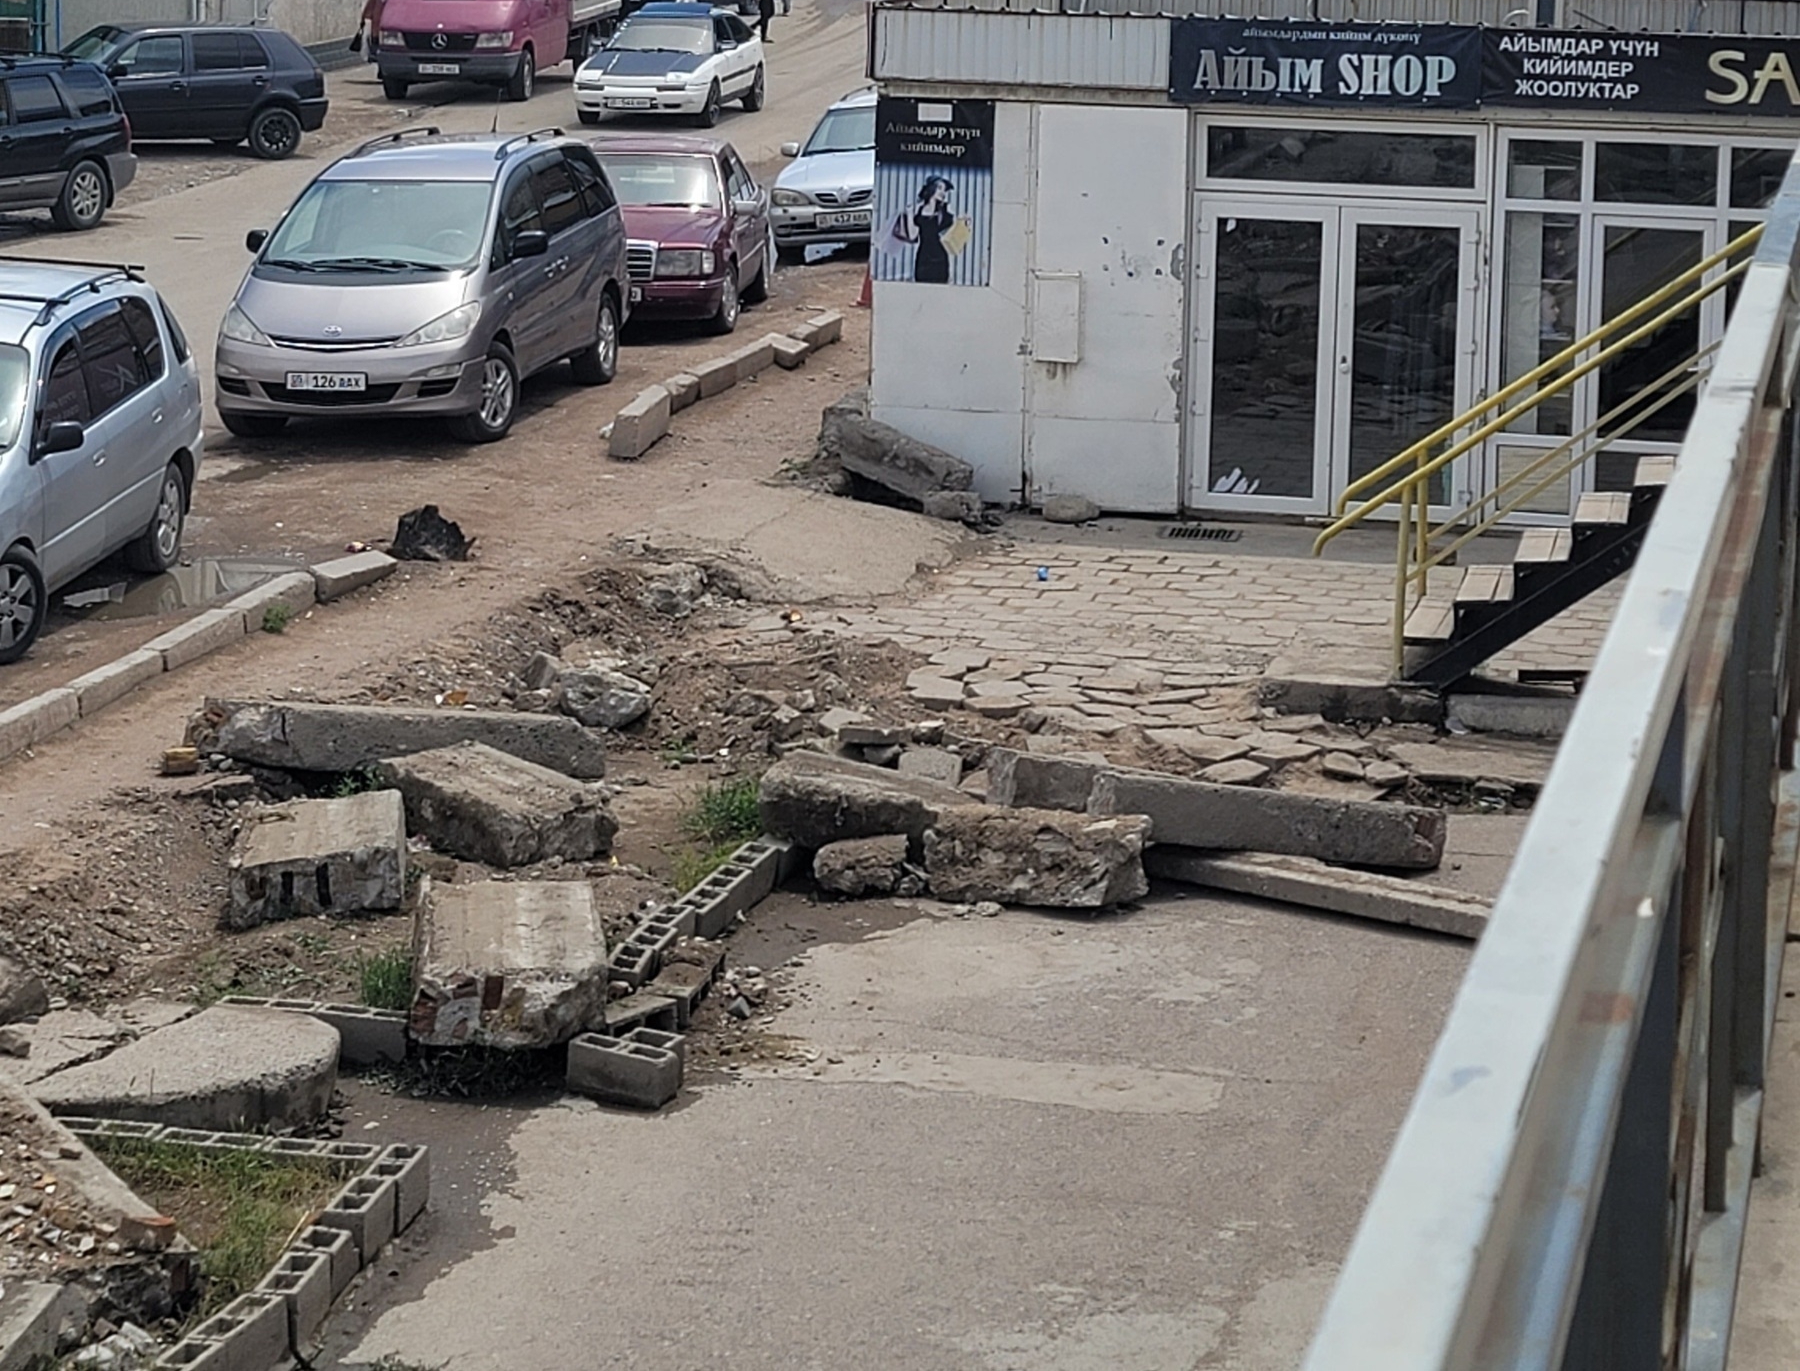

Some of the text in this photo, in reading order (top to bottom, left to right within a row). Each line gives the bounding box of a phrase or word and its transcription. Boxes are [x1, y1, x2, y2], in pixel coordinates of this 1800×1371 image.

[1499, 32, 1660, 58] АЙЫМДАР ҮЧҮН
[1337, 52, 1457, 97] SHOP
[1522, 55, 1634, 78] КИЙИМДЕР
[1514, 79, 1640, 100] ЖООЛУКТАР
[312, 375, 337, 388] 126
